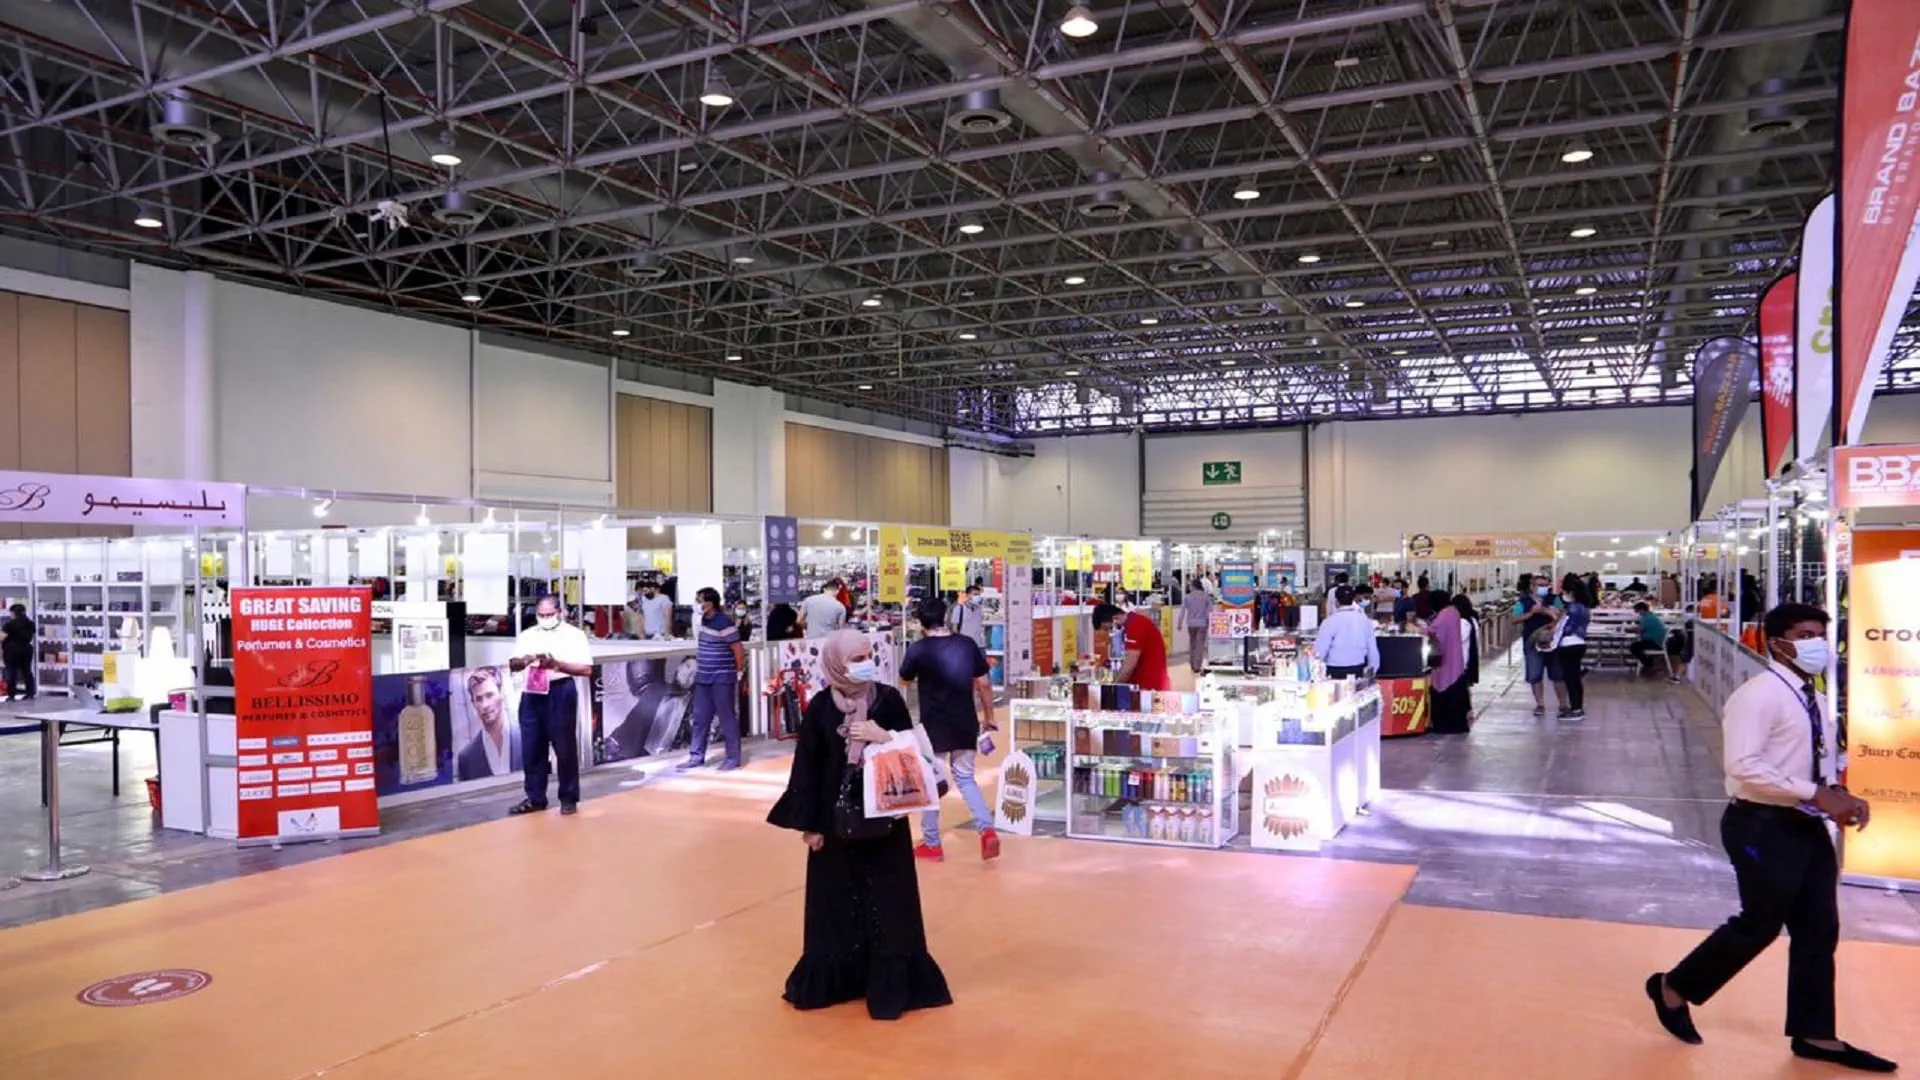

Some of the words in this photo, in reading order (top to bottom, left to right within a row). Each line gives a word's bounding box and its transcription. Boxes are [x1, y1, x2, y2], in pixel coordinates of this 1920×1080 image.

[1862, 121, 1907, 224] BRAND
[82, 489, 226, 519] بليسيمو
[240, 598, 295, 616] GREAT
[298, 596, 362, 613] SAVING
[251, 618, 284, 632] HUGE
[287, 615, 353, 631] Collection
[237, 638, 292, 652] Perfumes
[295, 637, 303, 649] &
[306, 634, 366, 649] Cosmetics
[251, 693, 360, 710] BELLISSIMO
[1857, 744, 1893, 757] Juicy
